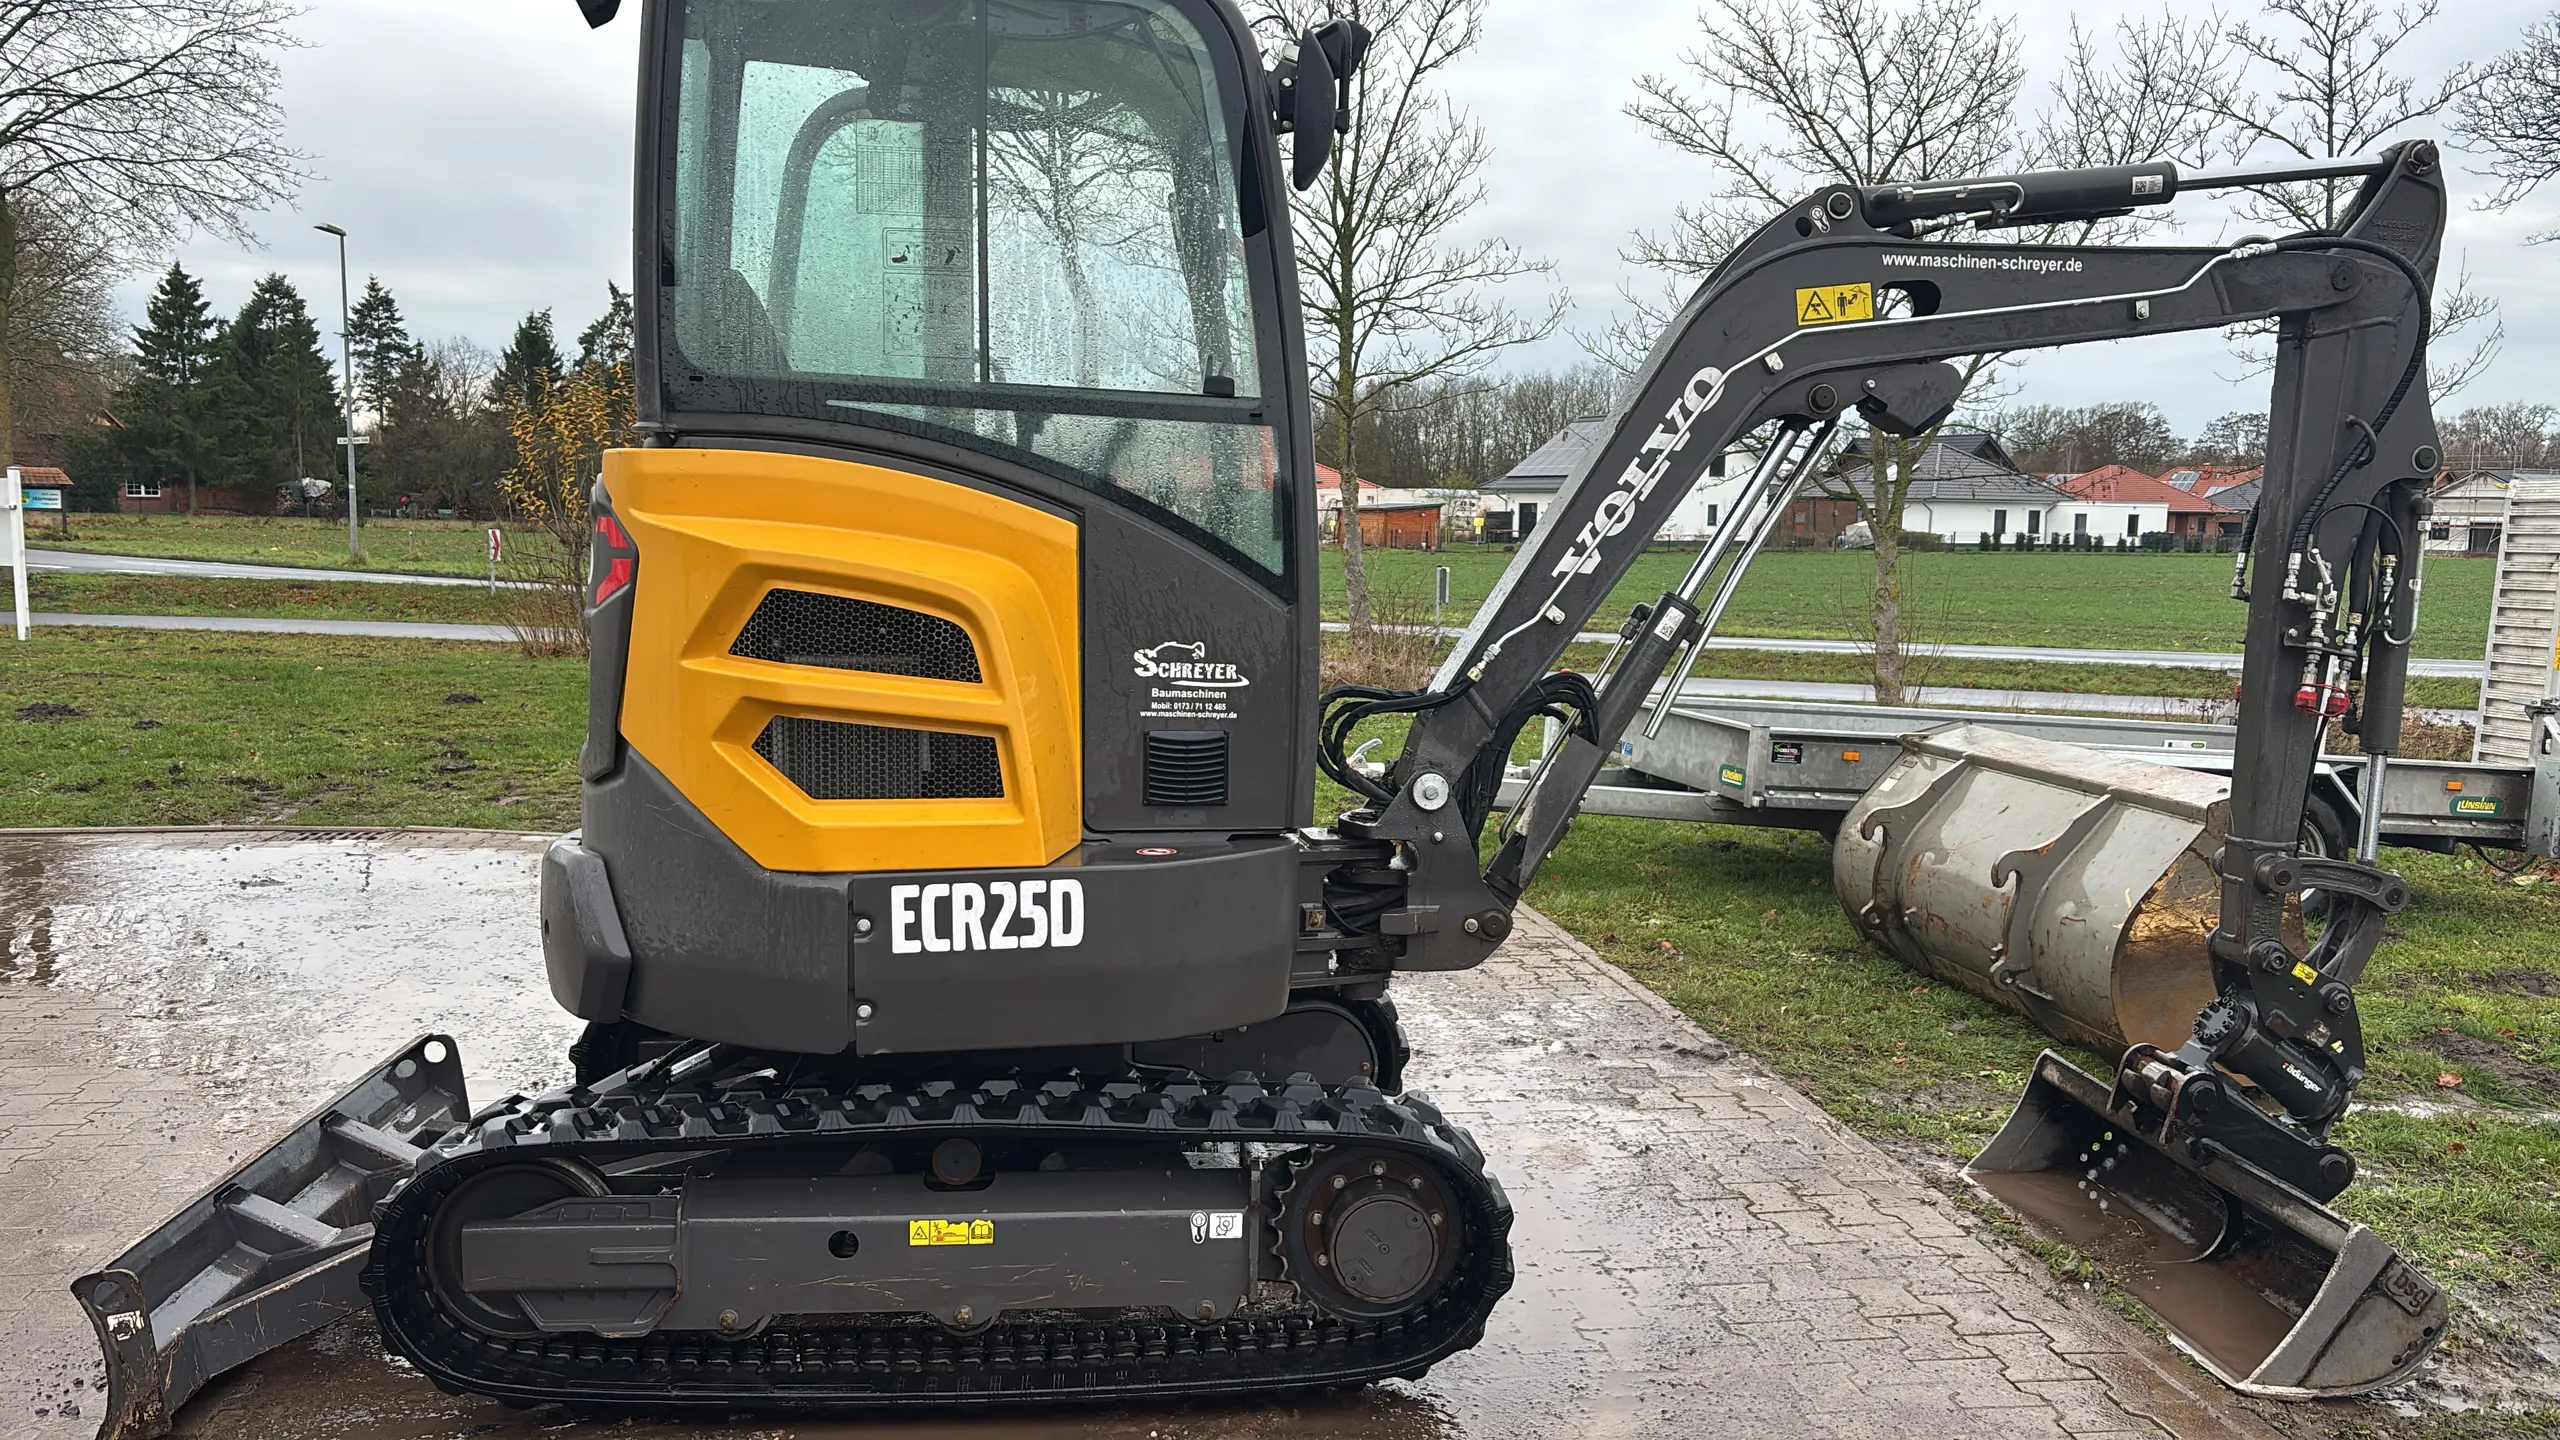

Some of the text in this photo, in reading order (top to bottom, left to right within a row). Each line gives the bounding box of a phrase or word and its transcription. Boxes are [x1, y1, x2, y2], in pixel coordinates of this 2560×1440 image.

[1882, 254, 2083, 274] www.maschinen-schreyer.de
[1551, 366, 1725, 578] VOLVO
[1134, 648, 1238, 679] SCHREYER
[1151, 688, 1227, 698] Baumaschinen
[1151, 701, 1172, 710] Mobil:
[1173, 702, 1190, 710] 0173
[1190, 702, 1194, 710] /
[1195, 703, 1203, 711] 71
[1204, 703, 1213, 711] 12
[1140, 710, 1238, 720] www.maschinen-schreyer.de
[2460, 796, 2497, 811] UNSINN
[890, 878, 1085, 954] ECR25D
